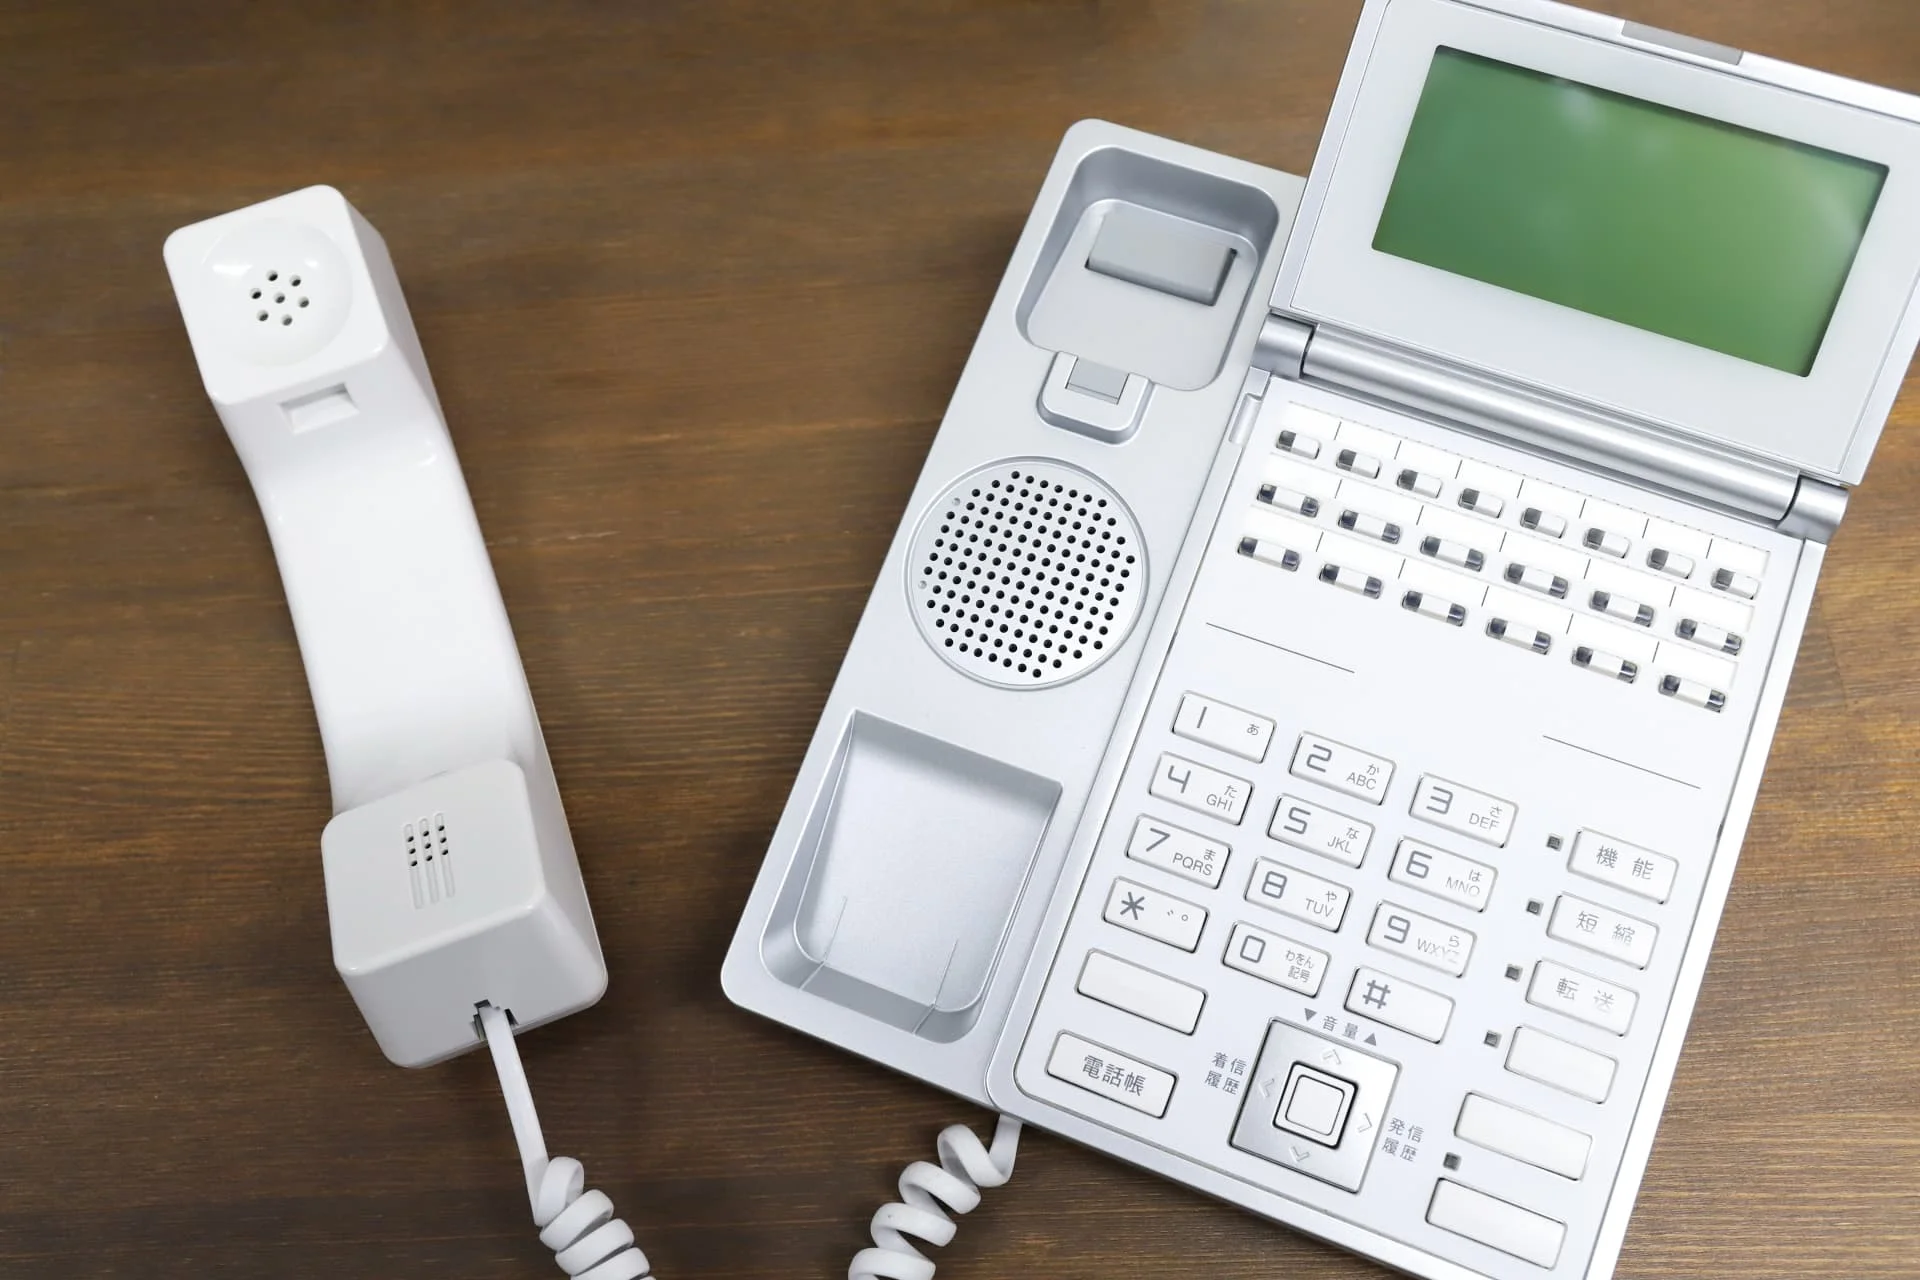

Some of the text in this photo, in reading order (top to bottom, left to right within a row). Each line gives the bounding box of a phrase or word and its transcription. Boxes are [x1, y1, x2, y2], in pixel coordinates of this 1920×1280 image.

[1197, 706, 1207, 728] 1
[1246, 723, 1260, 736] あ
[1306, 744, 1333, 773] 2
[1366, 763, 1380, 776] か
[1167, 765, 1191, 794] 4
[1346, 772, 1377, 791] ABC
[1206, 793, 1233, 812] GHI
[1224, 785, 1238, 799] た
[1426, 786, 1454, 815] 3
[1283, 806, 1312, 835] 5
[1468, 812, 1500, 831] DEF
[1489, 806, 1503, 818] さ
[1145, 827, 1171, 852] 7
[1327, 835, 1352, 855] JKL
[1346, 827, 1360, 840] な
[1172, 852, 1214, 876] PQRS
[1204, 849, 1217, 862] ま
[1405, 850, 1433, 879] 6
[1596, 845, 1654, 881] 機能
[1261, 870, 1288, 899] 8
[1445, 876, 1481, 897] MNO
[1468, 869, 1483, 883] は
[1306, 897, 1334, 918] TUV
[1325, 890, 1338, 903] や
[1384, 915, 1412, 944] 9
[1576, 910, 1635, 946] 短縮
[1239, 935, 1266, 964] 0
[1448, 935, 1460, 948] ら
[1285, 949, 1315, 969] わをん
[1287, 965, 1311, 984] 記号
[1556, 977, 1616, 1014] 転送
[1323, 1015, 1360, 1040] 音量
[1082, 1055, 1147, 1097] 電話帳
[1212, 1051, 1248, 1078] 着信
[1204, 1071, 1240, 1096] 履歴
[1388, 1117, 1425, 1144] 発信
[1381, 1138, 1419, 1162] 履歴
